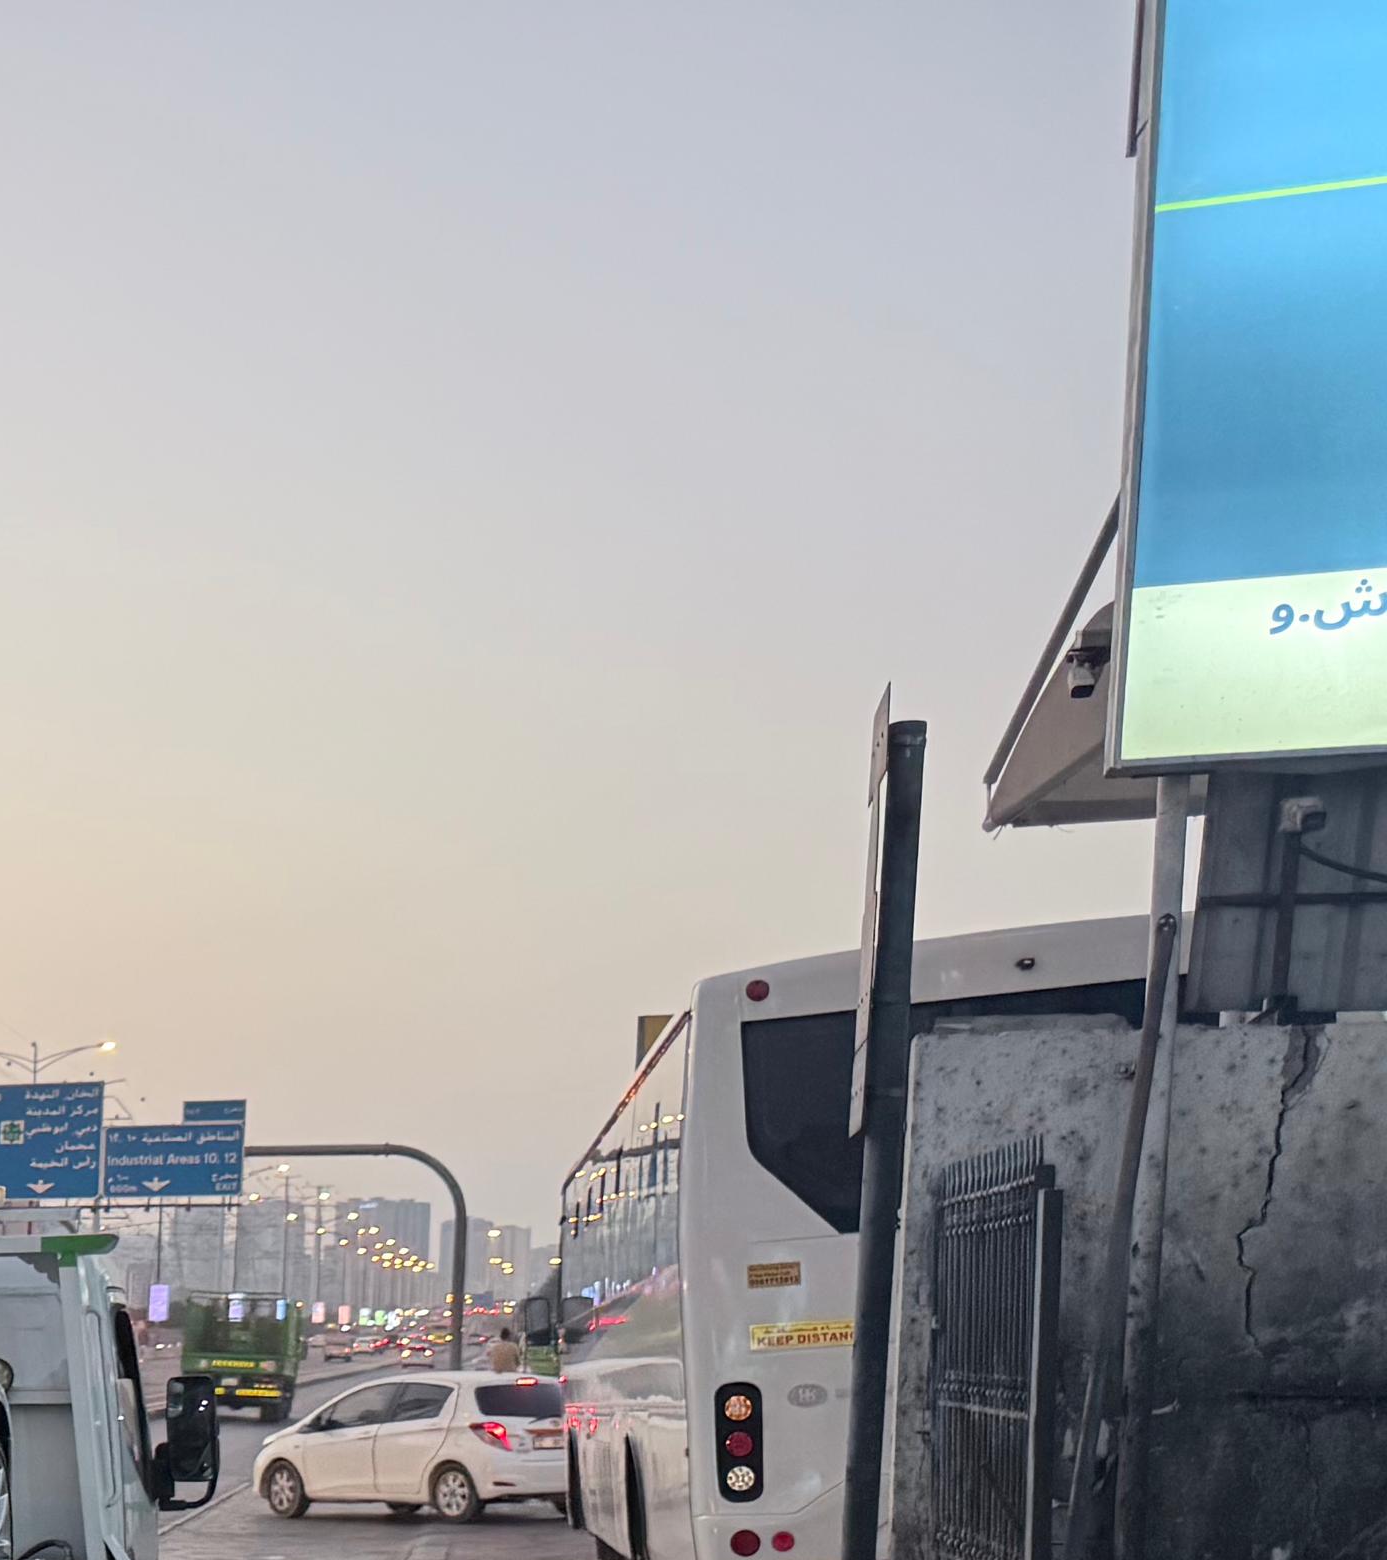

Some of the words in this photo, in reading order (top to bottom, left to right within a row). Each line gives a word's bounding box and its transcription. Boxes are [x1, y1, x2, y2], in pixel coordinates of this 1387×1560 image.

[107, 1154, 163, 1166] Industrial
[166, 1153, 201, 1165] Areas
[224, 1152, 237, 1164] 12
[757, 1335, 794, 1347] KEEP
